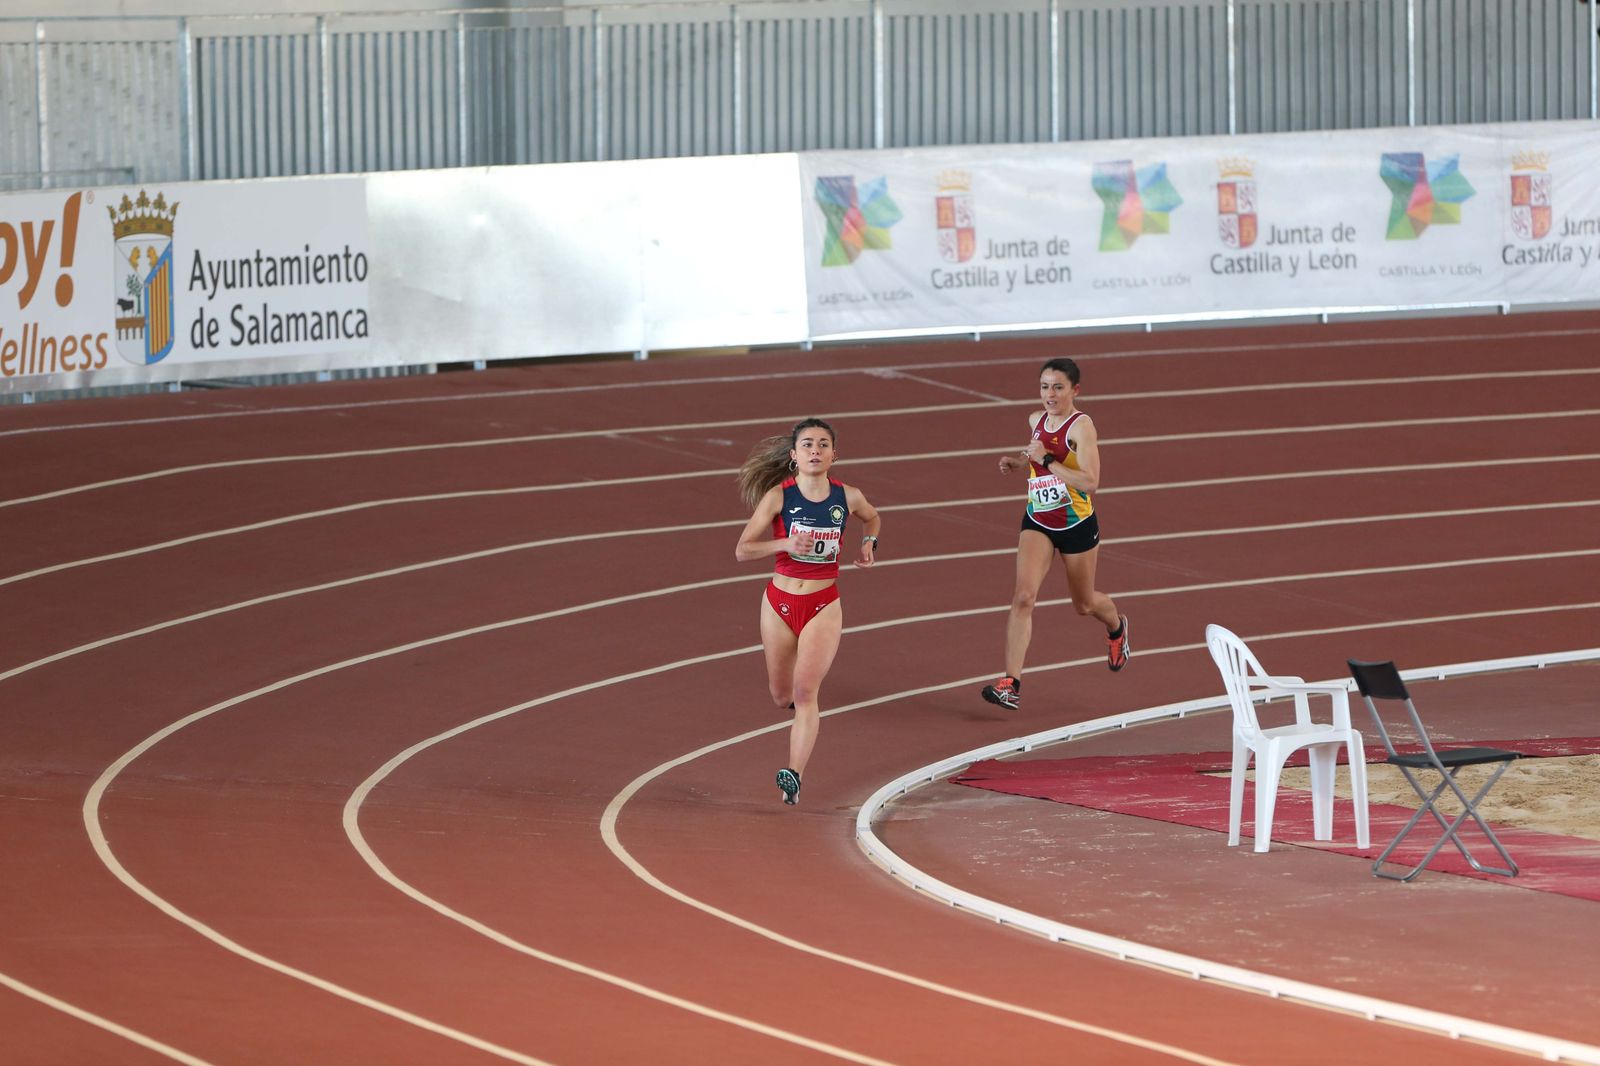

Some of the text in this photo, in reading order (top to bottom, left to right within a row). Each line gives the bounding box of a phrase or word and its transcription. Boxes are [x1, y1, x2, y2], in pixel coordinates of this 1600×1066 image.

[1266, 221, 1356, 246] Junta de
[984, 235, 1070, 260] Junta de
[1502, 243, 1573, 266] Castilla
[1580, 245, 1593, 268] y
[189, 244, 368, 301] Ayuntamiento
[1209, 248, 1358, 278] Castilla y León
[1379, 265, 1437, 278] CASTILLA
[930, 262, 1072, 293] Castilla y León
[1092, 276, 1149, 290] CASTILLA
[190, 302, 369, 349] de Salamanca
[0, 322, 108, 377] ellness
[1036, 486, 1060, 504] 193
